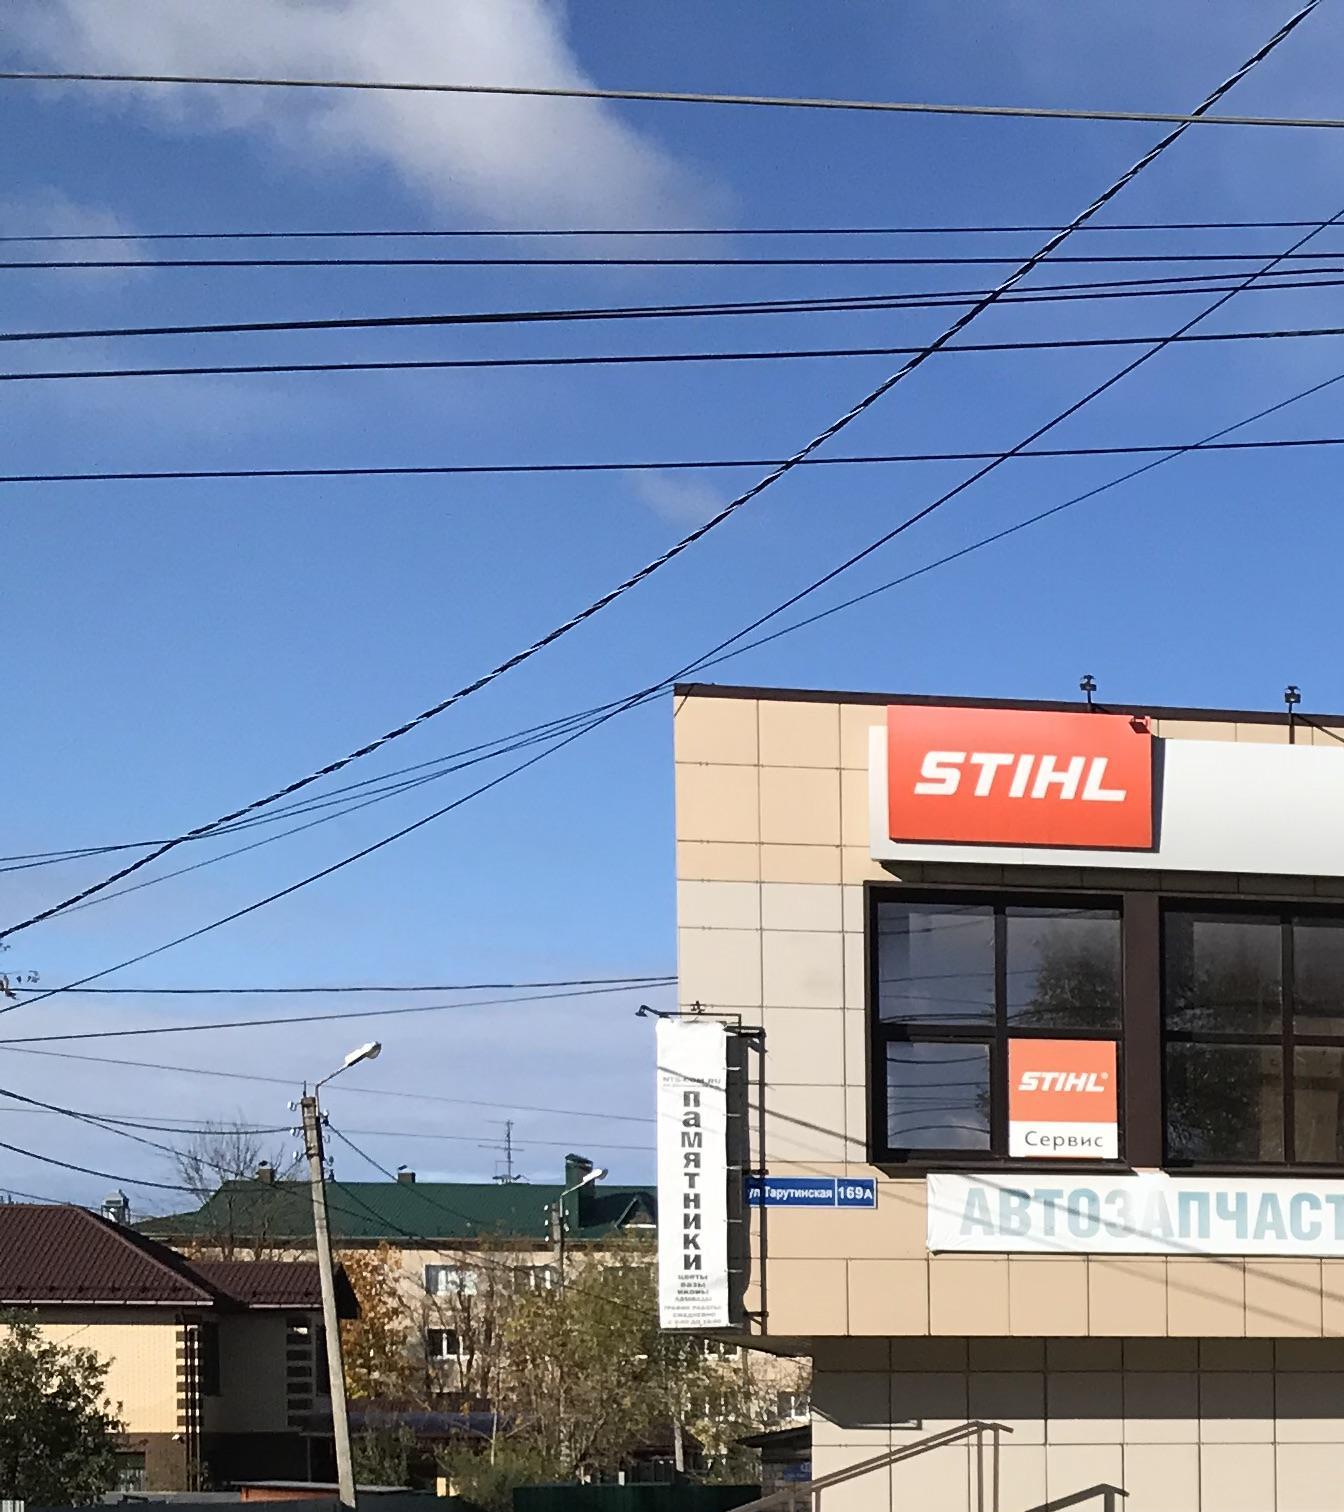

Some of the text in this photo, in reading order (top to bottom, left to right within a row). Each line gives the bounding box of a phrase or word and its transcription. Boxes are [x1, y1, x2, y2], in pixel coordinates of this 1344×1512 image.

[913, 751, 1127, 801] STIHL
[1018, 1071, 1105, 1093] STIHL
[1024, 1130, 1104, 1151] Сервис
[764, 1185, 833, 1201] Тарутинская
